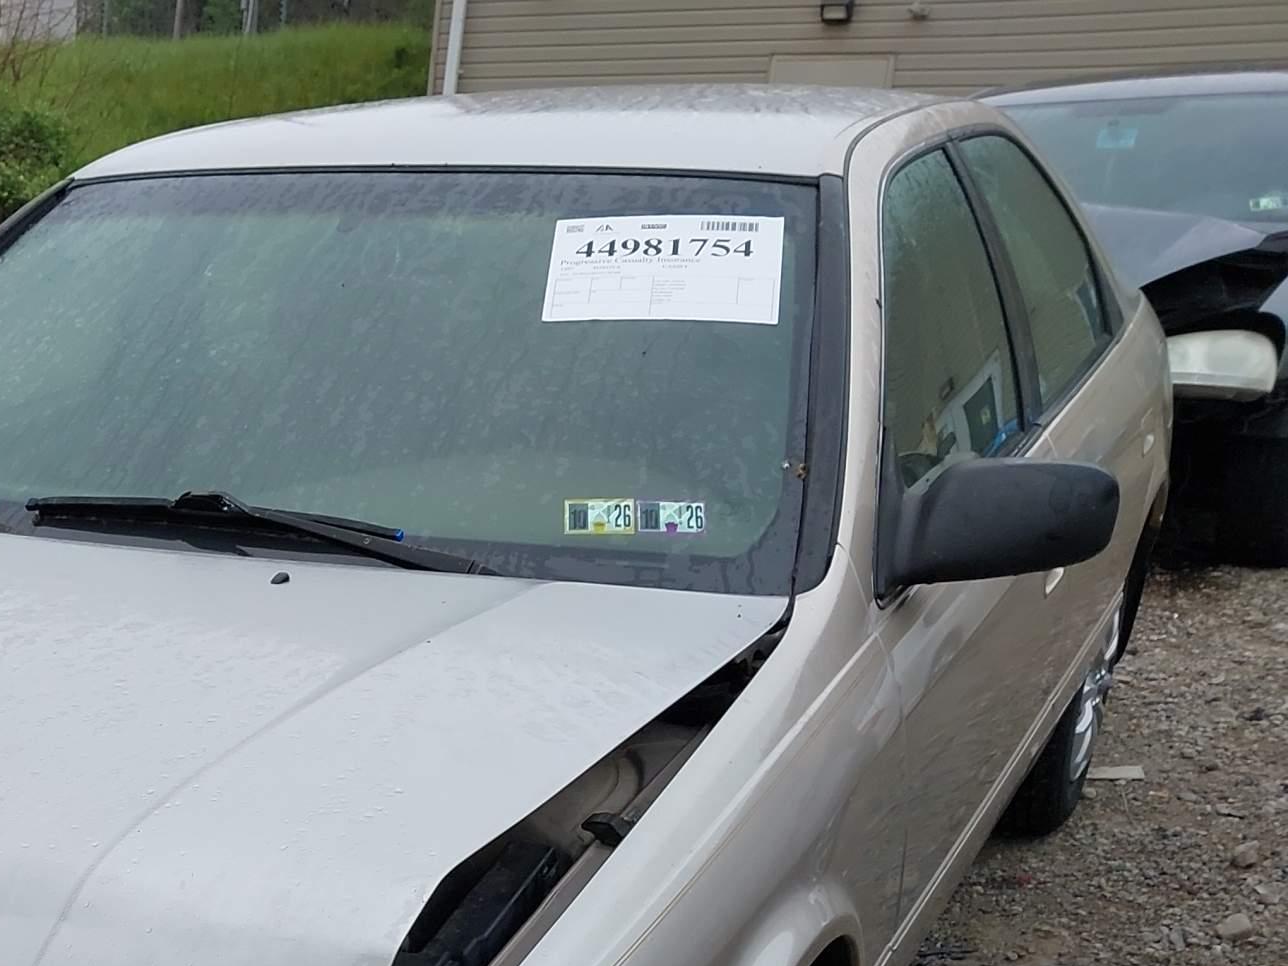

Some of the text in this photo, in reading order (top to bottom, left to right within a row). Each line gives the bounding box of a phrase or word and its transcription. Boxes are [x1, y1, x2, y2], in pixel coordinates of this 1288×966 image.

[576, 239, 752, 257] 44981754
[560, 259, 612, 267] Progressive
[615, 504, 631, 528] 26
[686, 505, 704, 529] 26
